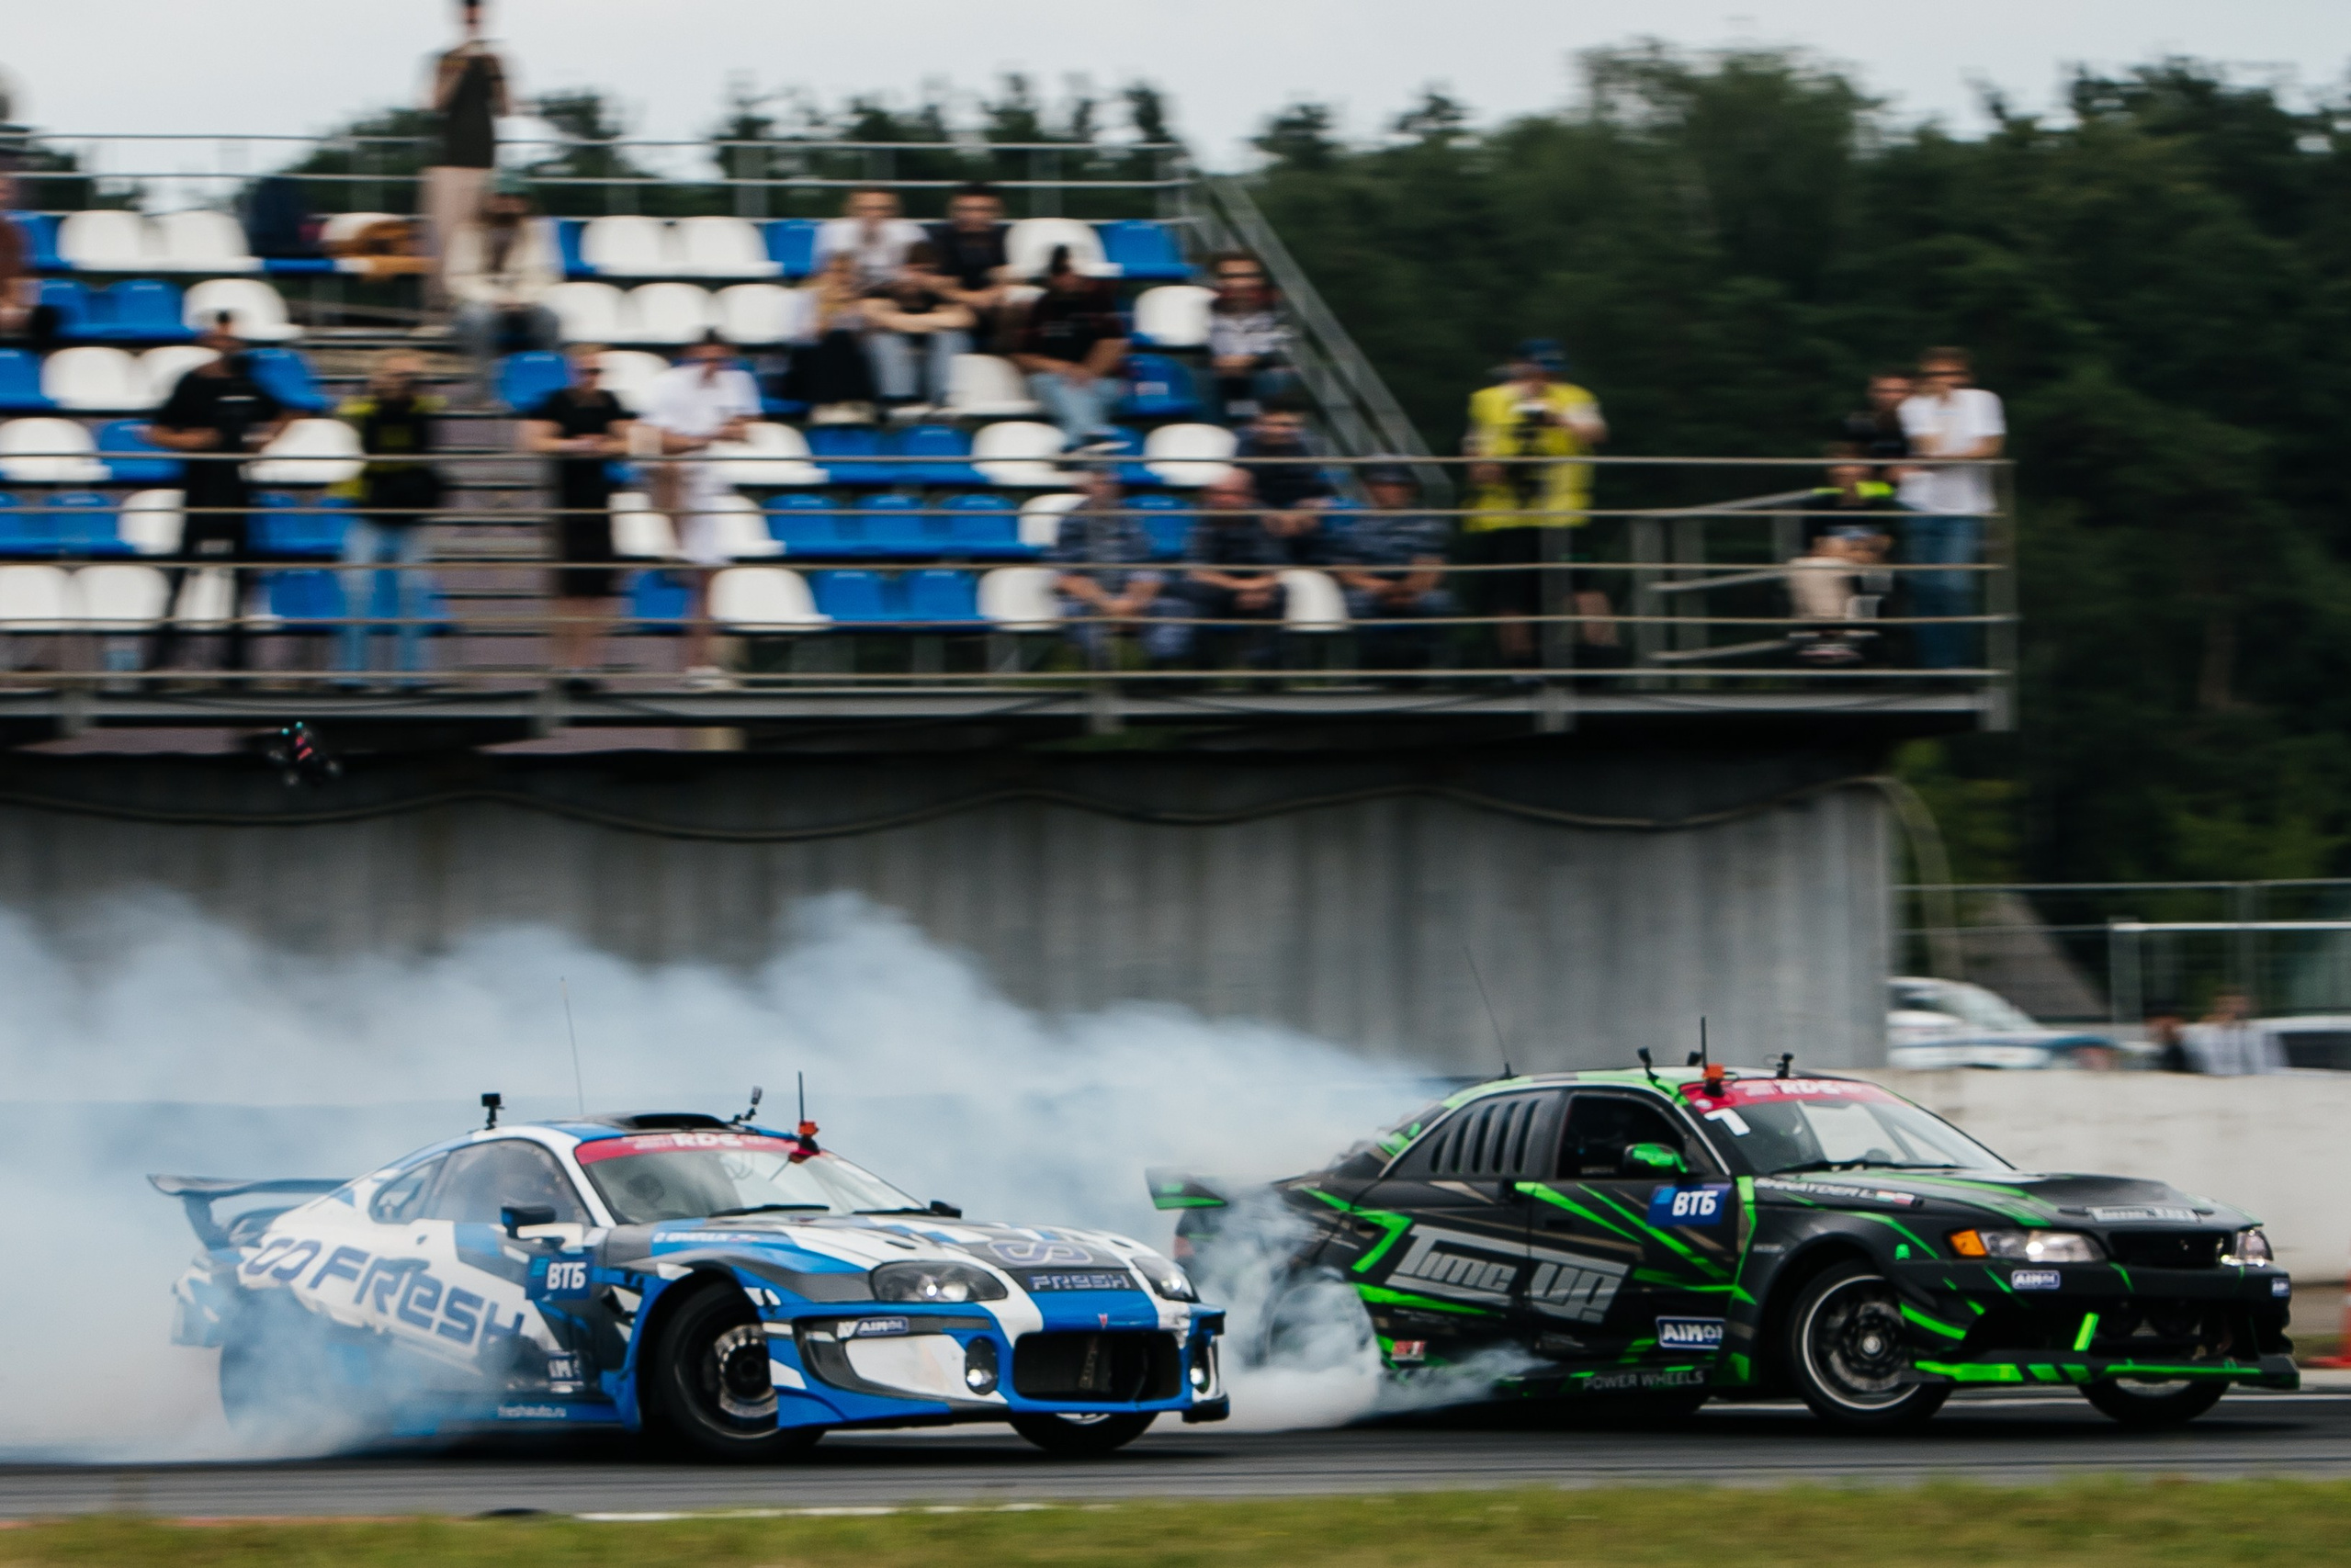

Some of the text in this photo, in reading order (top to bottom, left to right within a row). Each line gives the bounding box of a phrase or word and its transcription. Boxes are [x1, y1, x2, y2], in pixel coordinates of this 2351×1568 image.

[1775, 1078, 1840, 1095] RDS
[672, 1133, 743, 1147] RDS
[1671, 1190, 1718, 1217] ВТБ
[547, 1261, 587, 1291] ВТБ
[1582, 1371, 1705, 1391] POWER WHEELS
